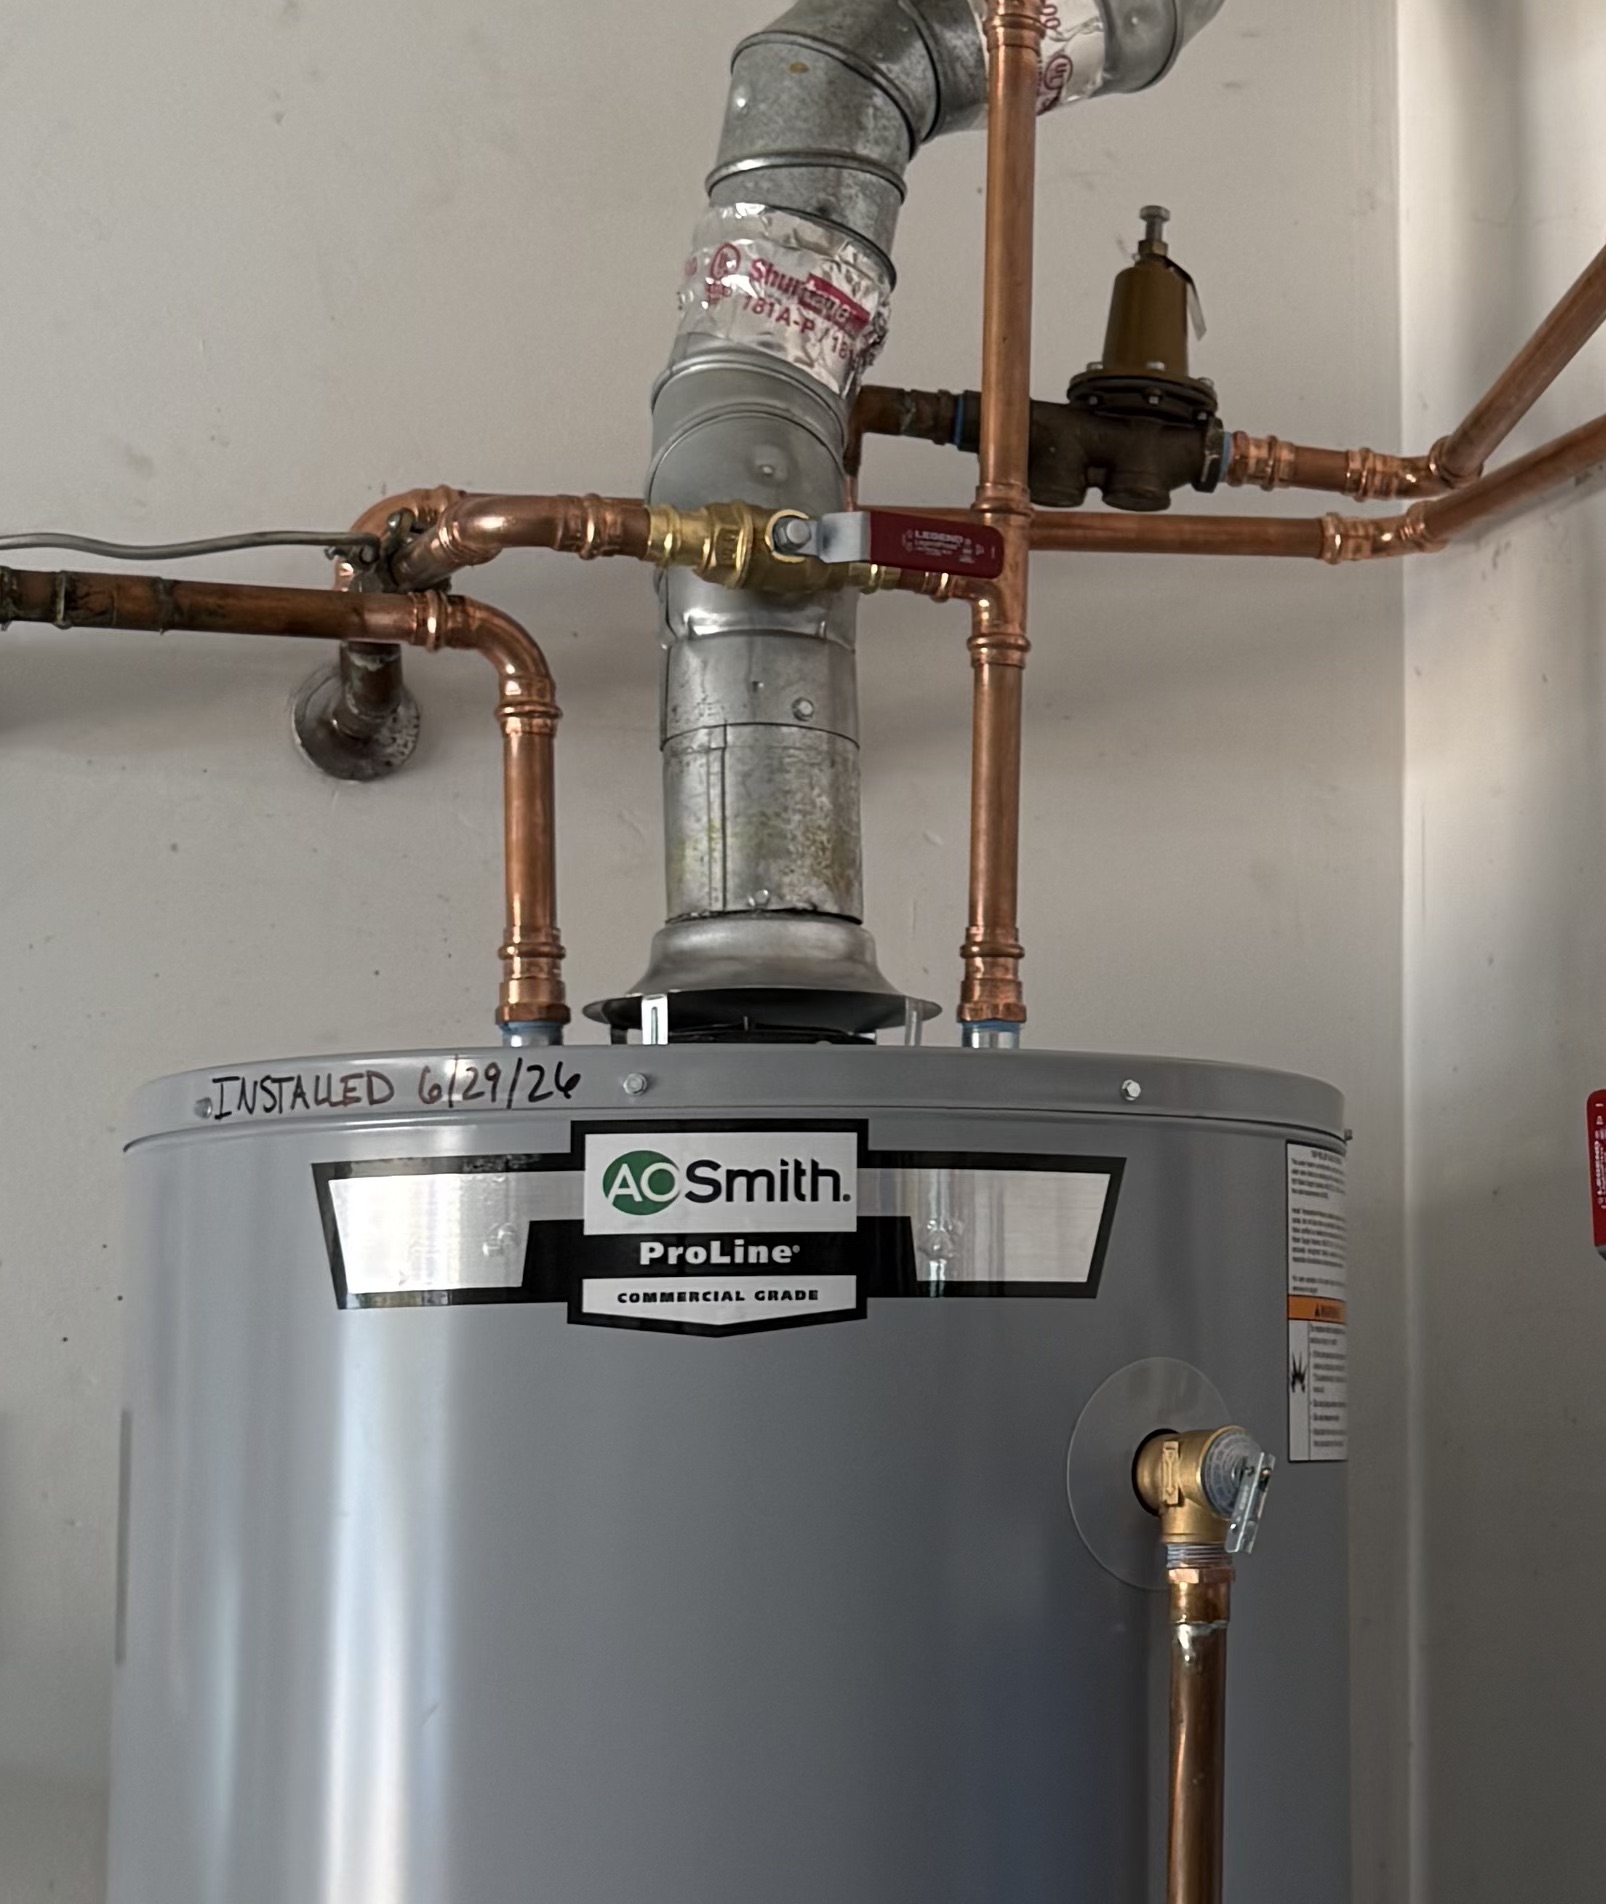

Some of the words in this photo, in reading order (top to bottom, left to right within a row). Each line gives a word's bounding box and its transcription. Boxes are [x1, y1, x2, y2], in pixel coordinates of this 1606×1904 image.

[212, 1071, 395, 1121] INSTALLED
[417, 1054, 582, 1111] 6/29/26
[617, 1290, 746, 1304] COMMERCIAL
[753, 1289, 820, 1302] GRADE
